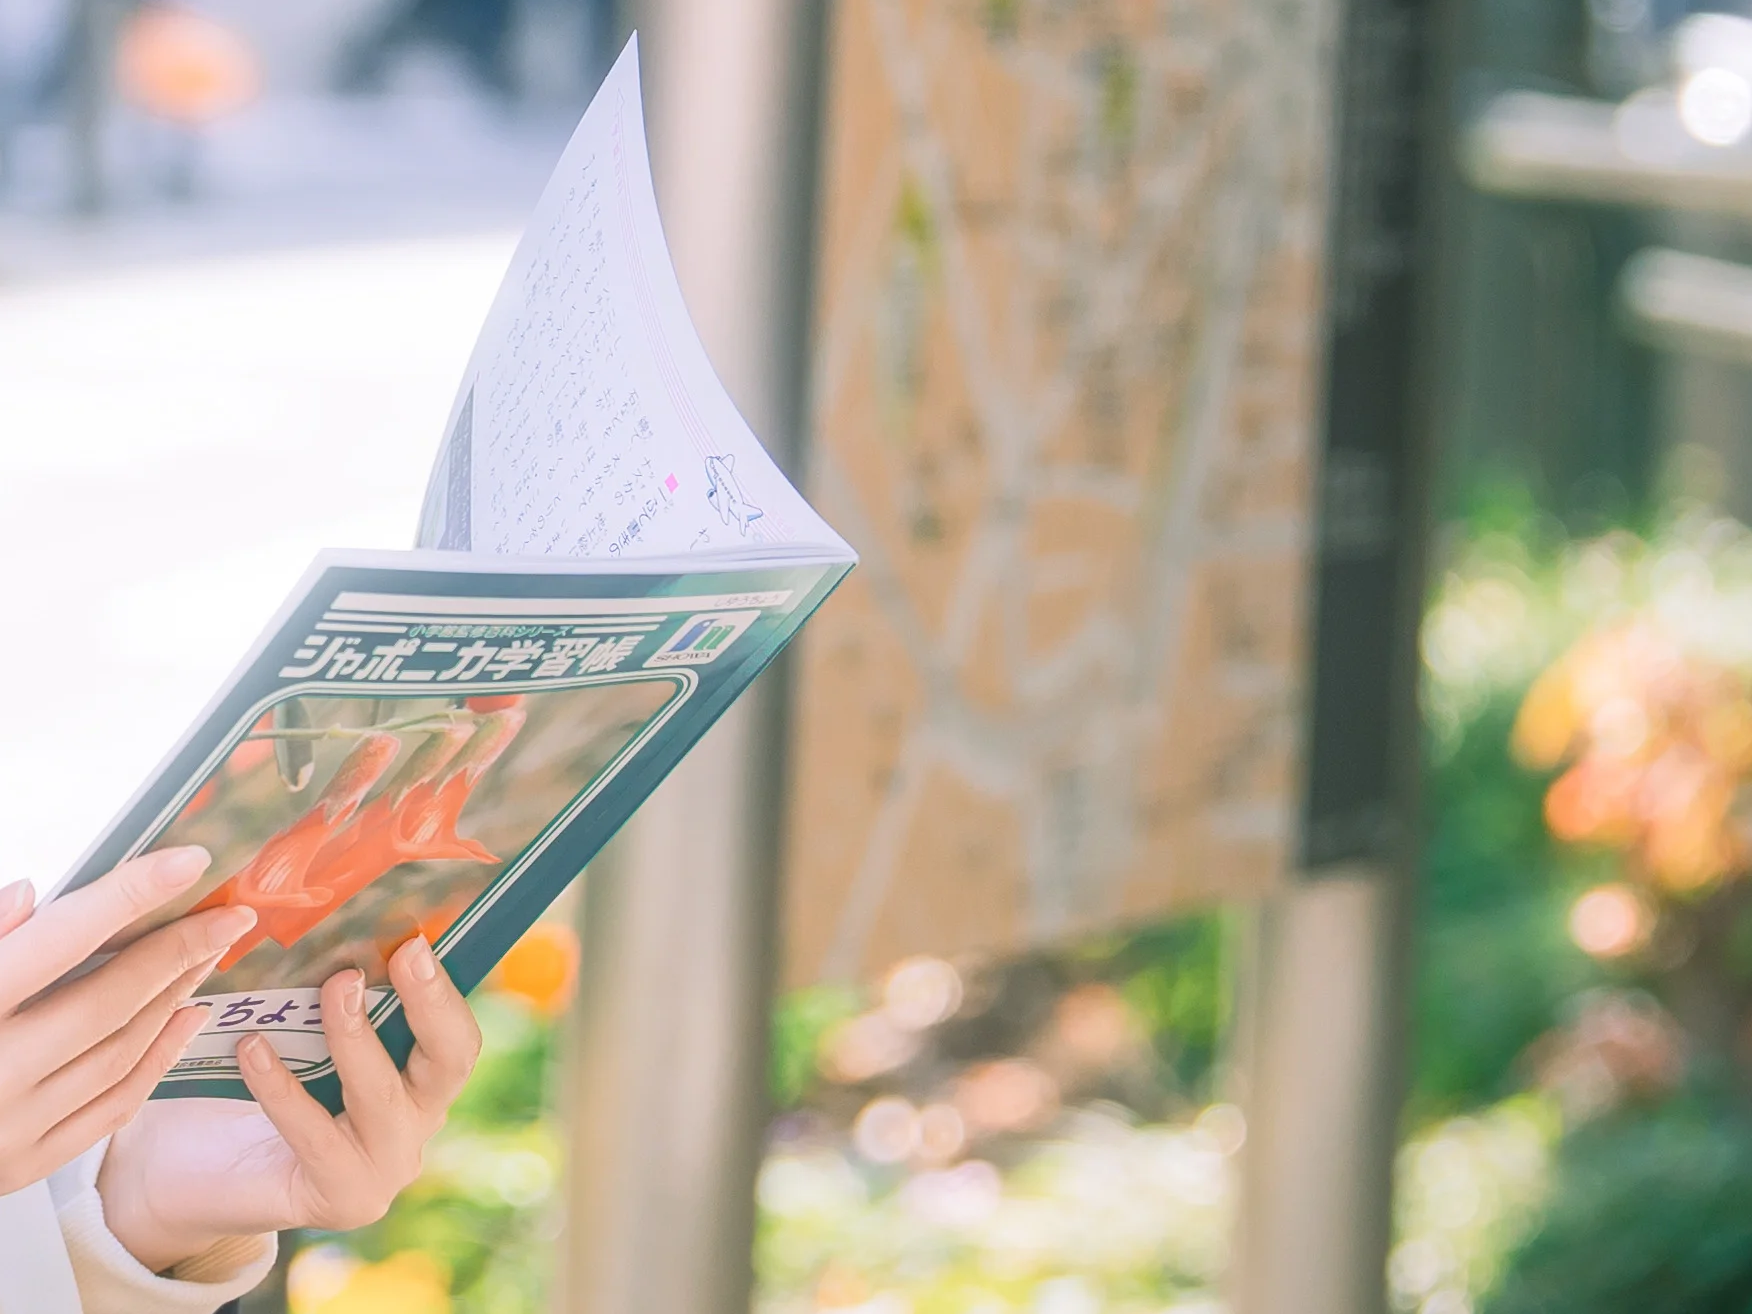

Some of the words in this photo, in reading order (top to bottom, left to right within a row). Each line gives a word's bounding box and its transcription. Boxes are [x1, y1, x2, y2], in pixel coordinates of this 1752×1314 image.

[278, 634, 646, 681] ジャポニカ学習帳
[653, 651, 711, 664] SHOWA
